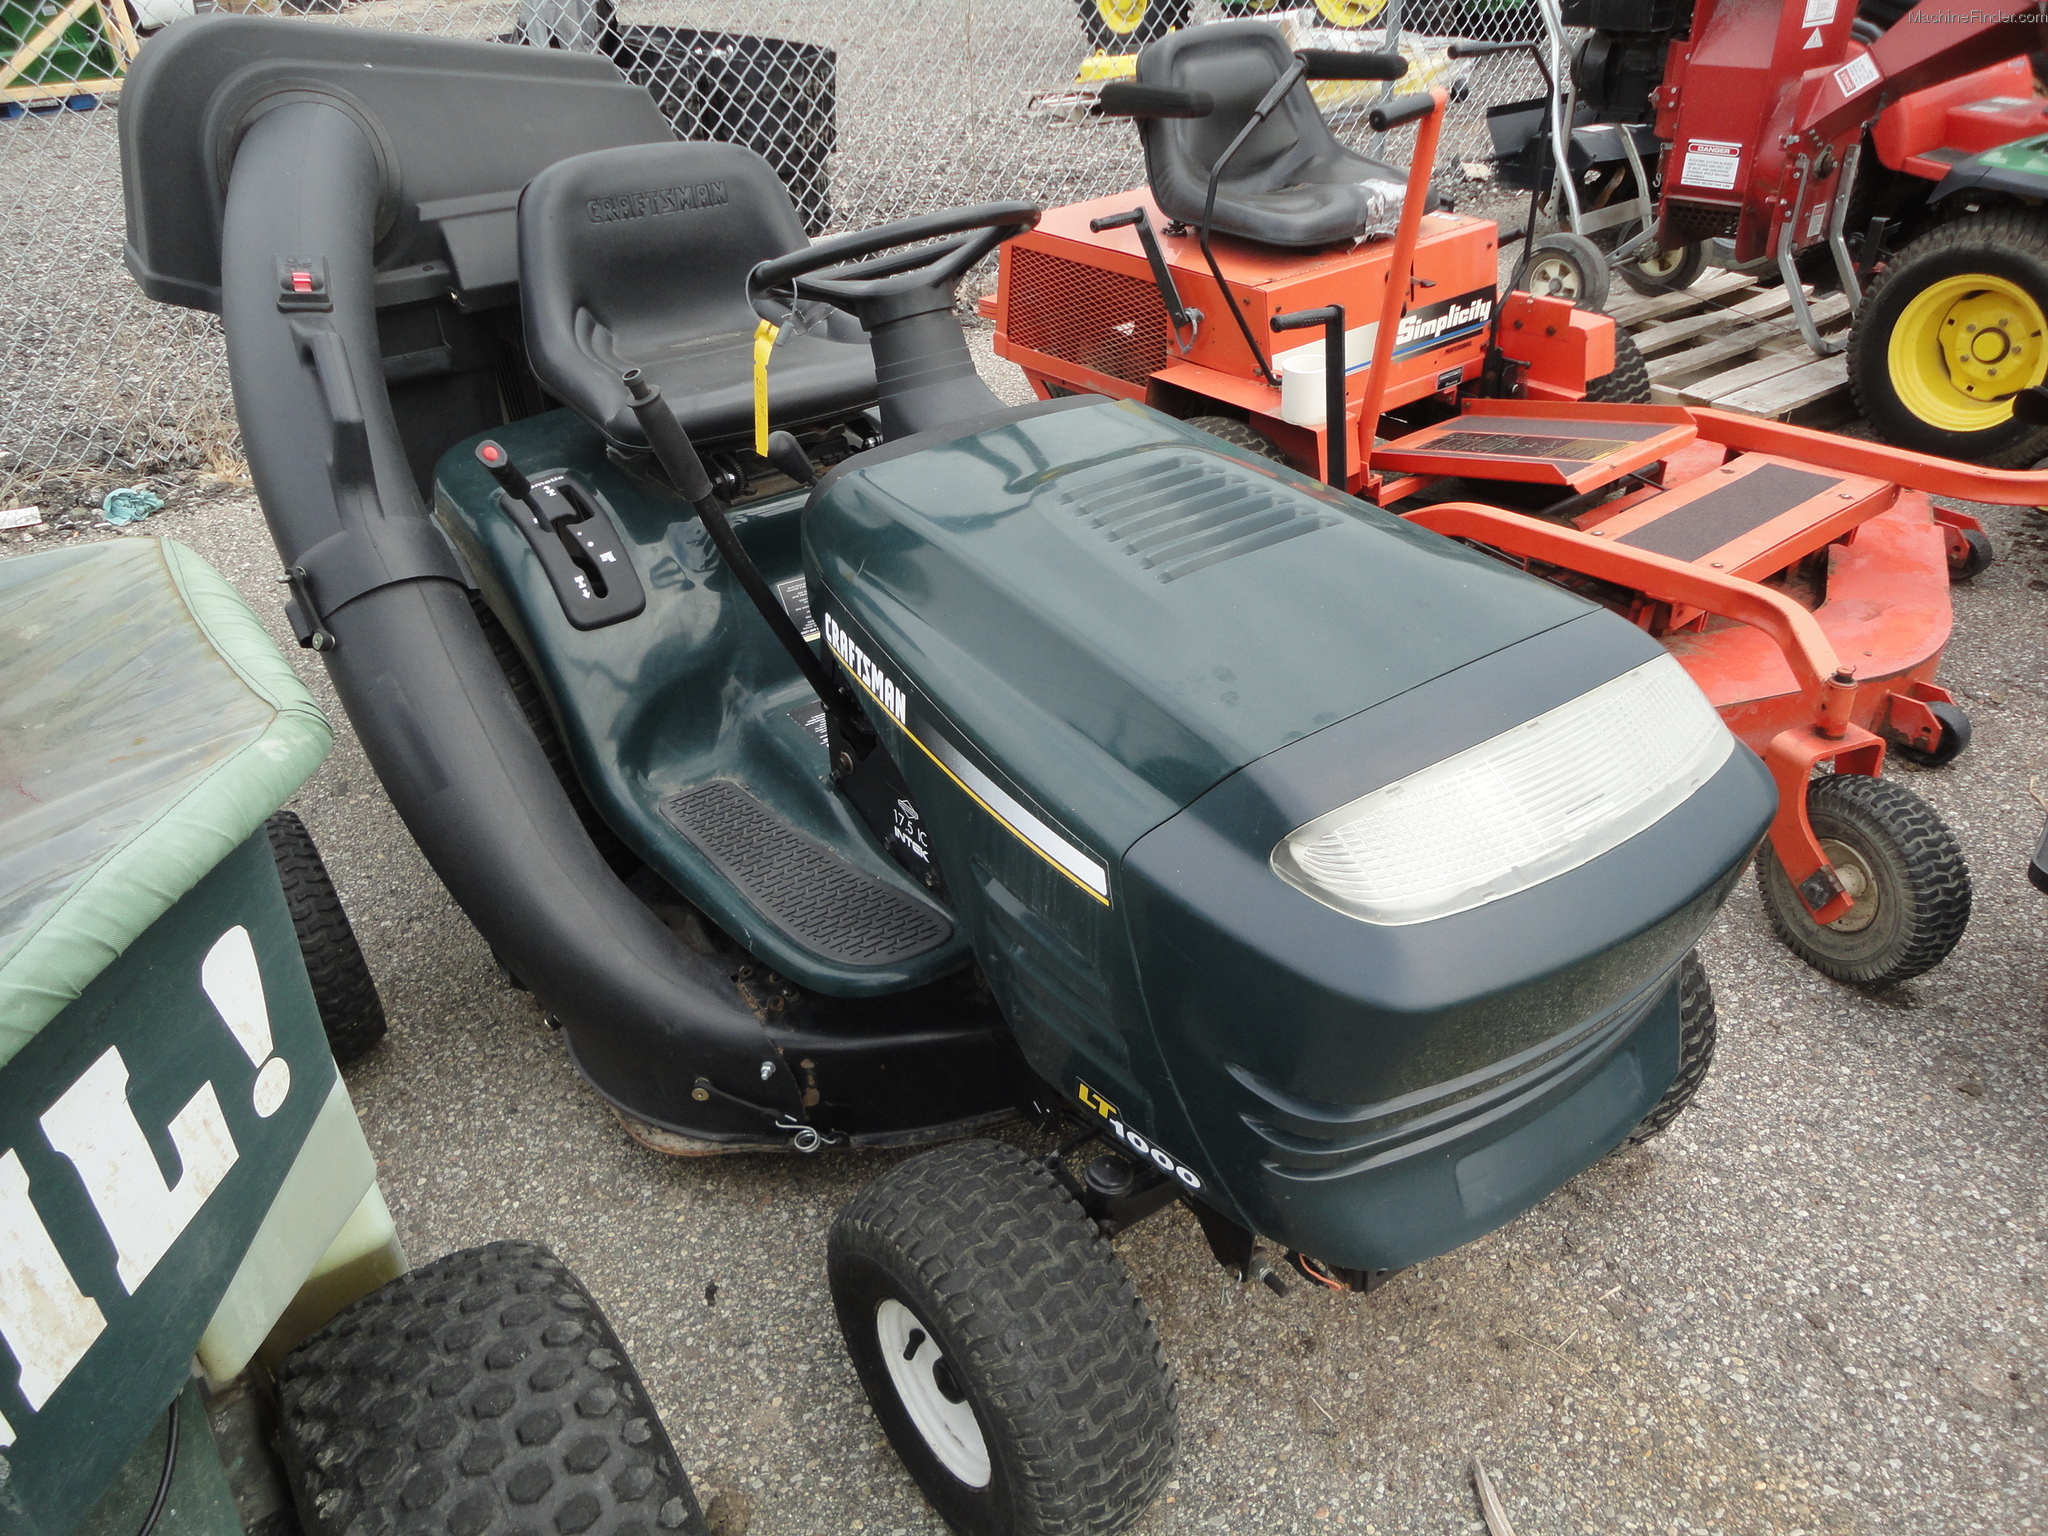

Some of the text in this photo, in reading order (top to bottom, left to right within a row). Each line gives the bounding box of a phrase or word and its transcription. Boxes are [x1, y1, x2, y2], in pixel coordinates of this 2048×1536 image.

[1697, 145, 1731, 155] DANGER
[586, 180, 728, 225] CRAFTSMAN
[1395, 298, 1492, 345] Simplicity
[824, 612, 907, 725] CRAFTSMAN
[893, 825, 930, 864] INTEK
